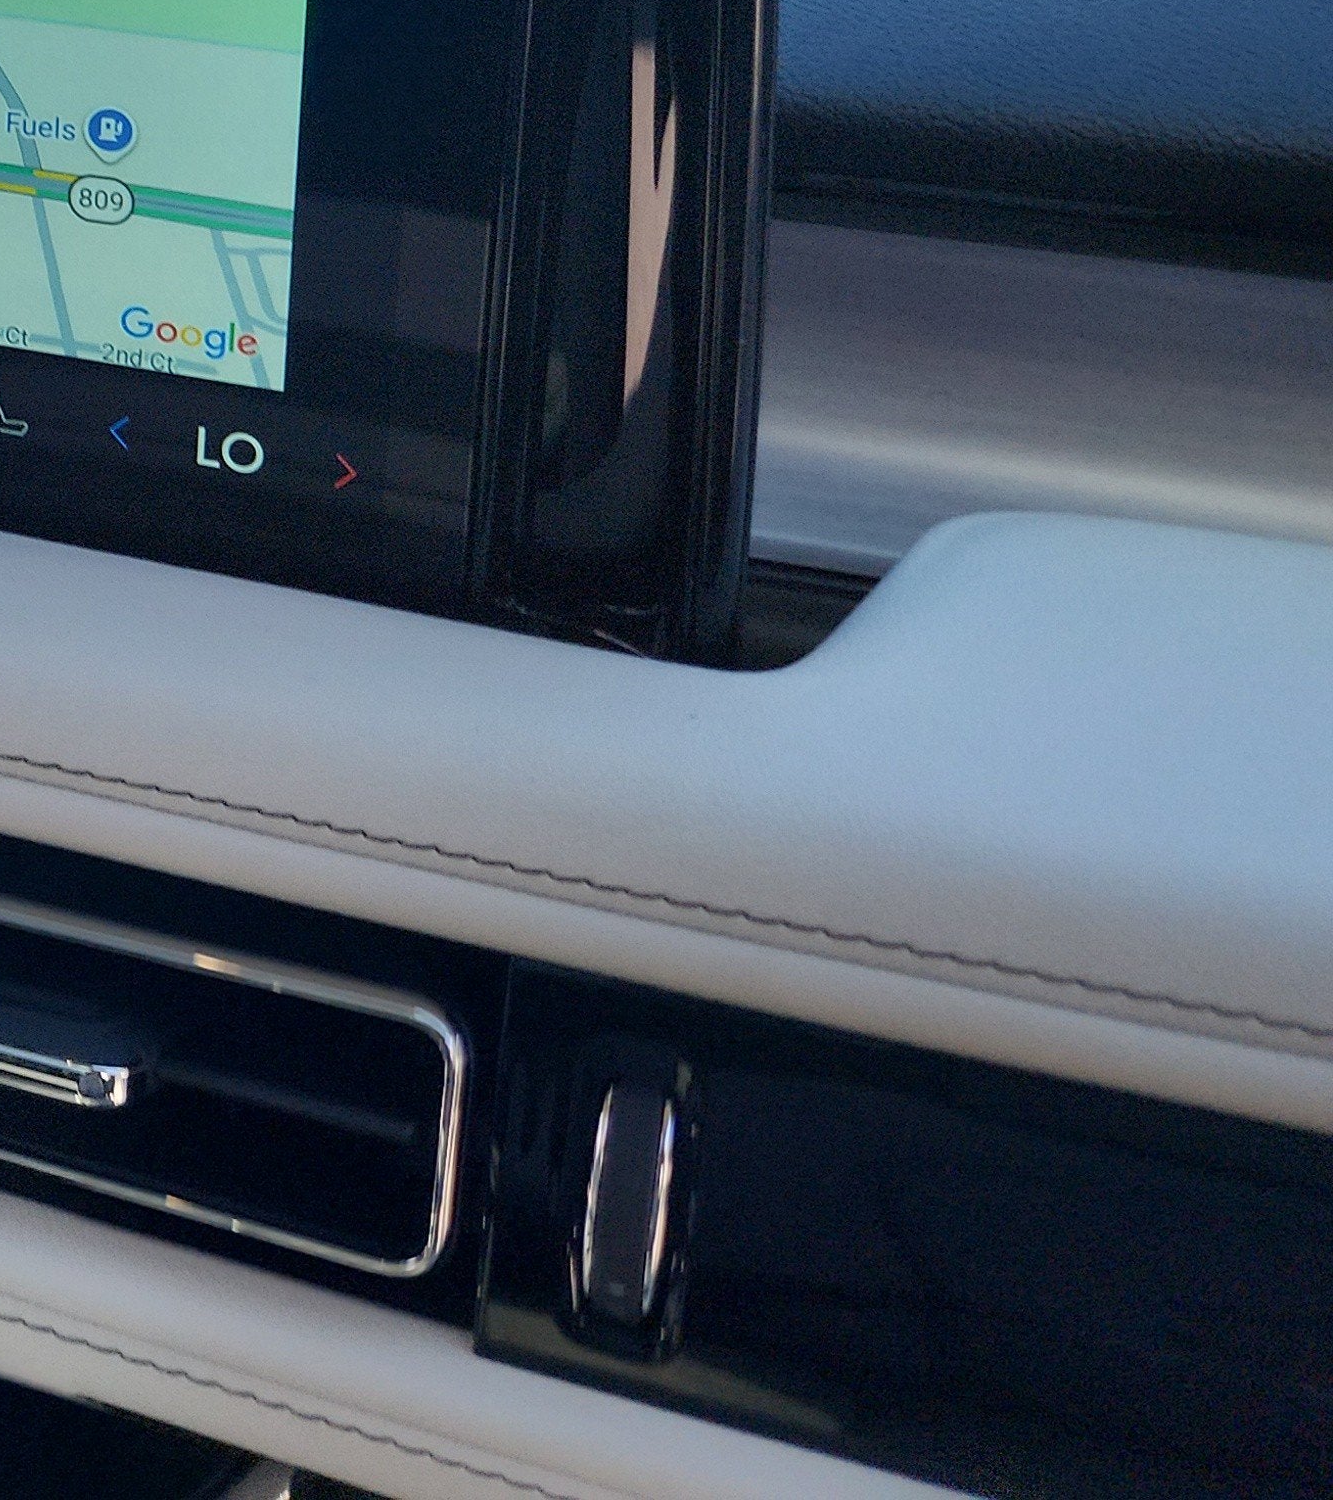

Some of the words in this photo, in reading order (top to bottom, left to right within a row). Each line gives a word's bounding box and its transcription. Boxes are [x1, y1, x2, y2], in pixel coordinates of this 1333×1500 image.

[6, 112, 76, 142] Fuels
[78, 188, 124, 213] 809
[4, 326, 29, 348] Ct
[120, 305, 258, 360] Google
[100, 342, 144, 367] 2nd
[151, 353, 176, 374] Ct
[196, 425, 264, 474] LO
